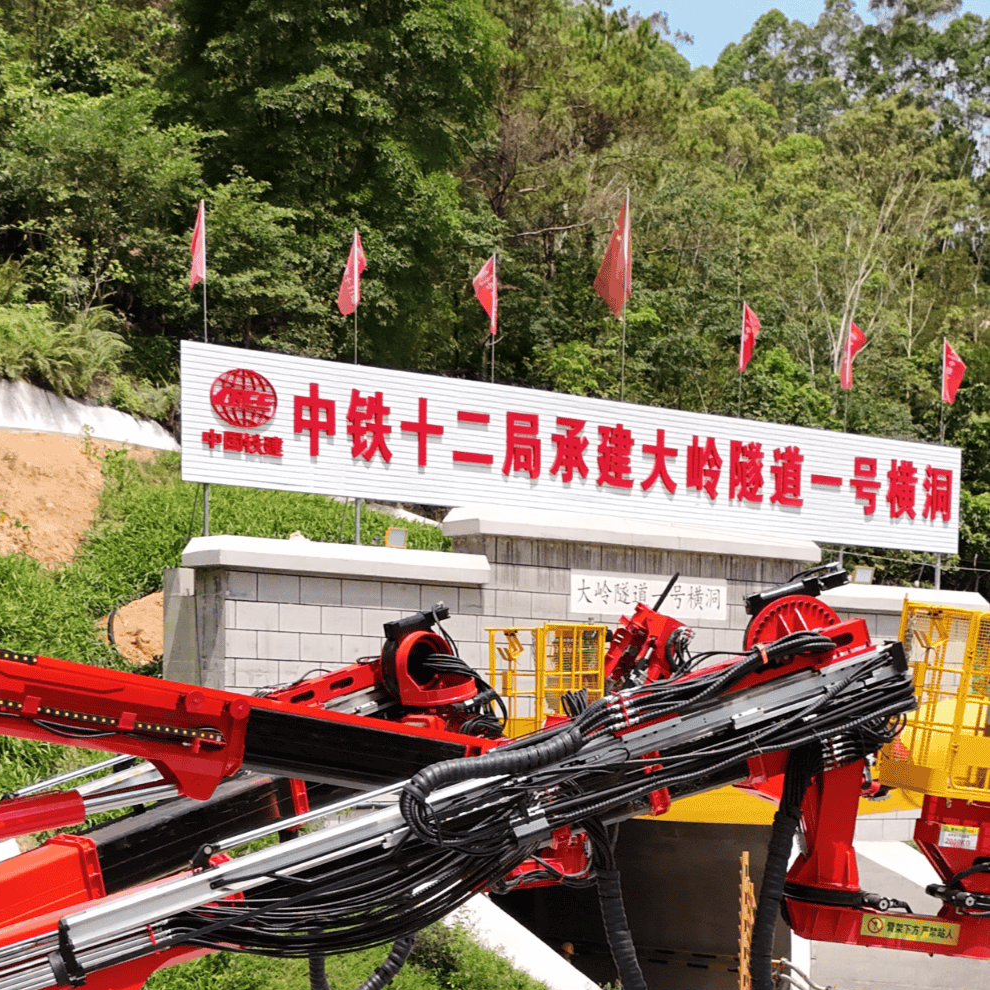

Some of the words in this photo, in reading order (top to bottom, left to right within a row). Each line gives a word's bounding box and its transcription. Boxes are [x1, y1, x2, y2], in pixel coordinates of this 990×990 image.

[201, 428, 284, 458] 中国铁建
[294, 382, 953, 523] 中铁十二局承建大岭隧道一号横洞
